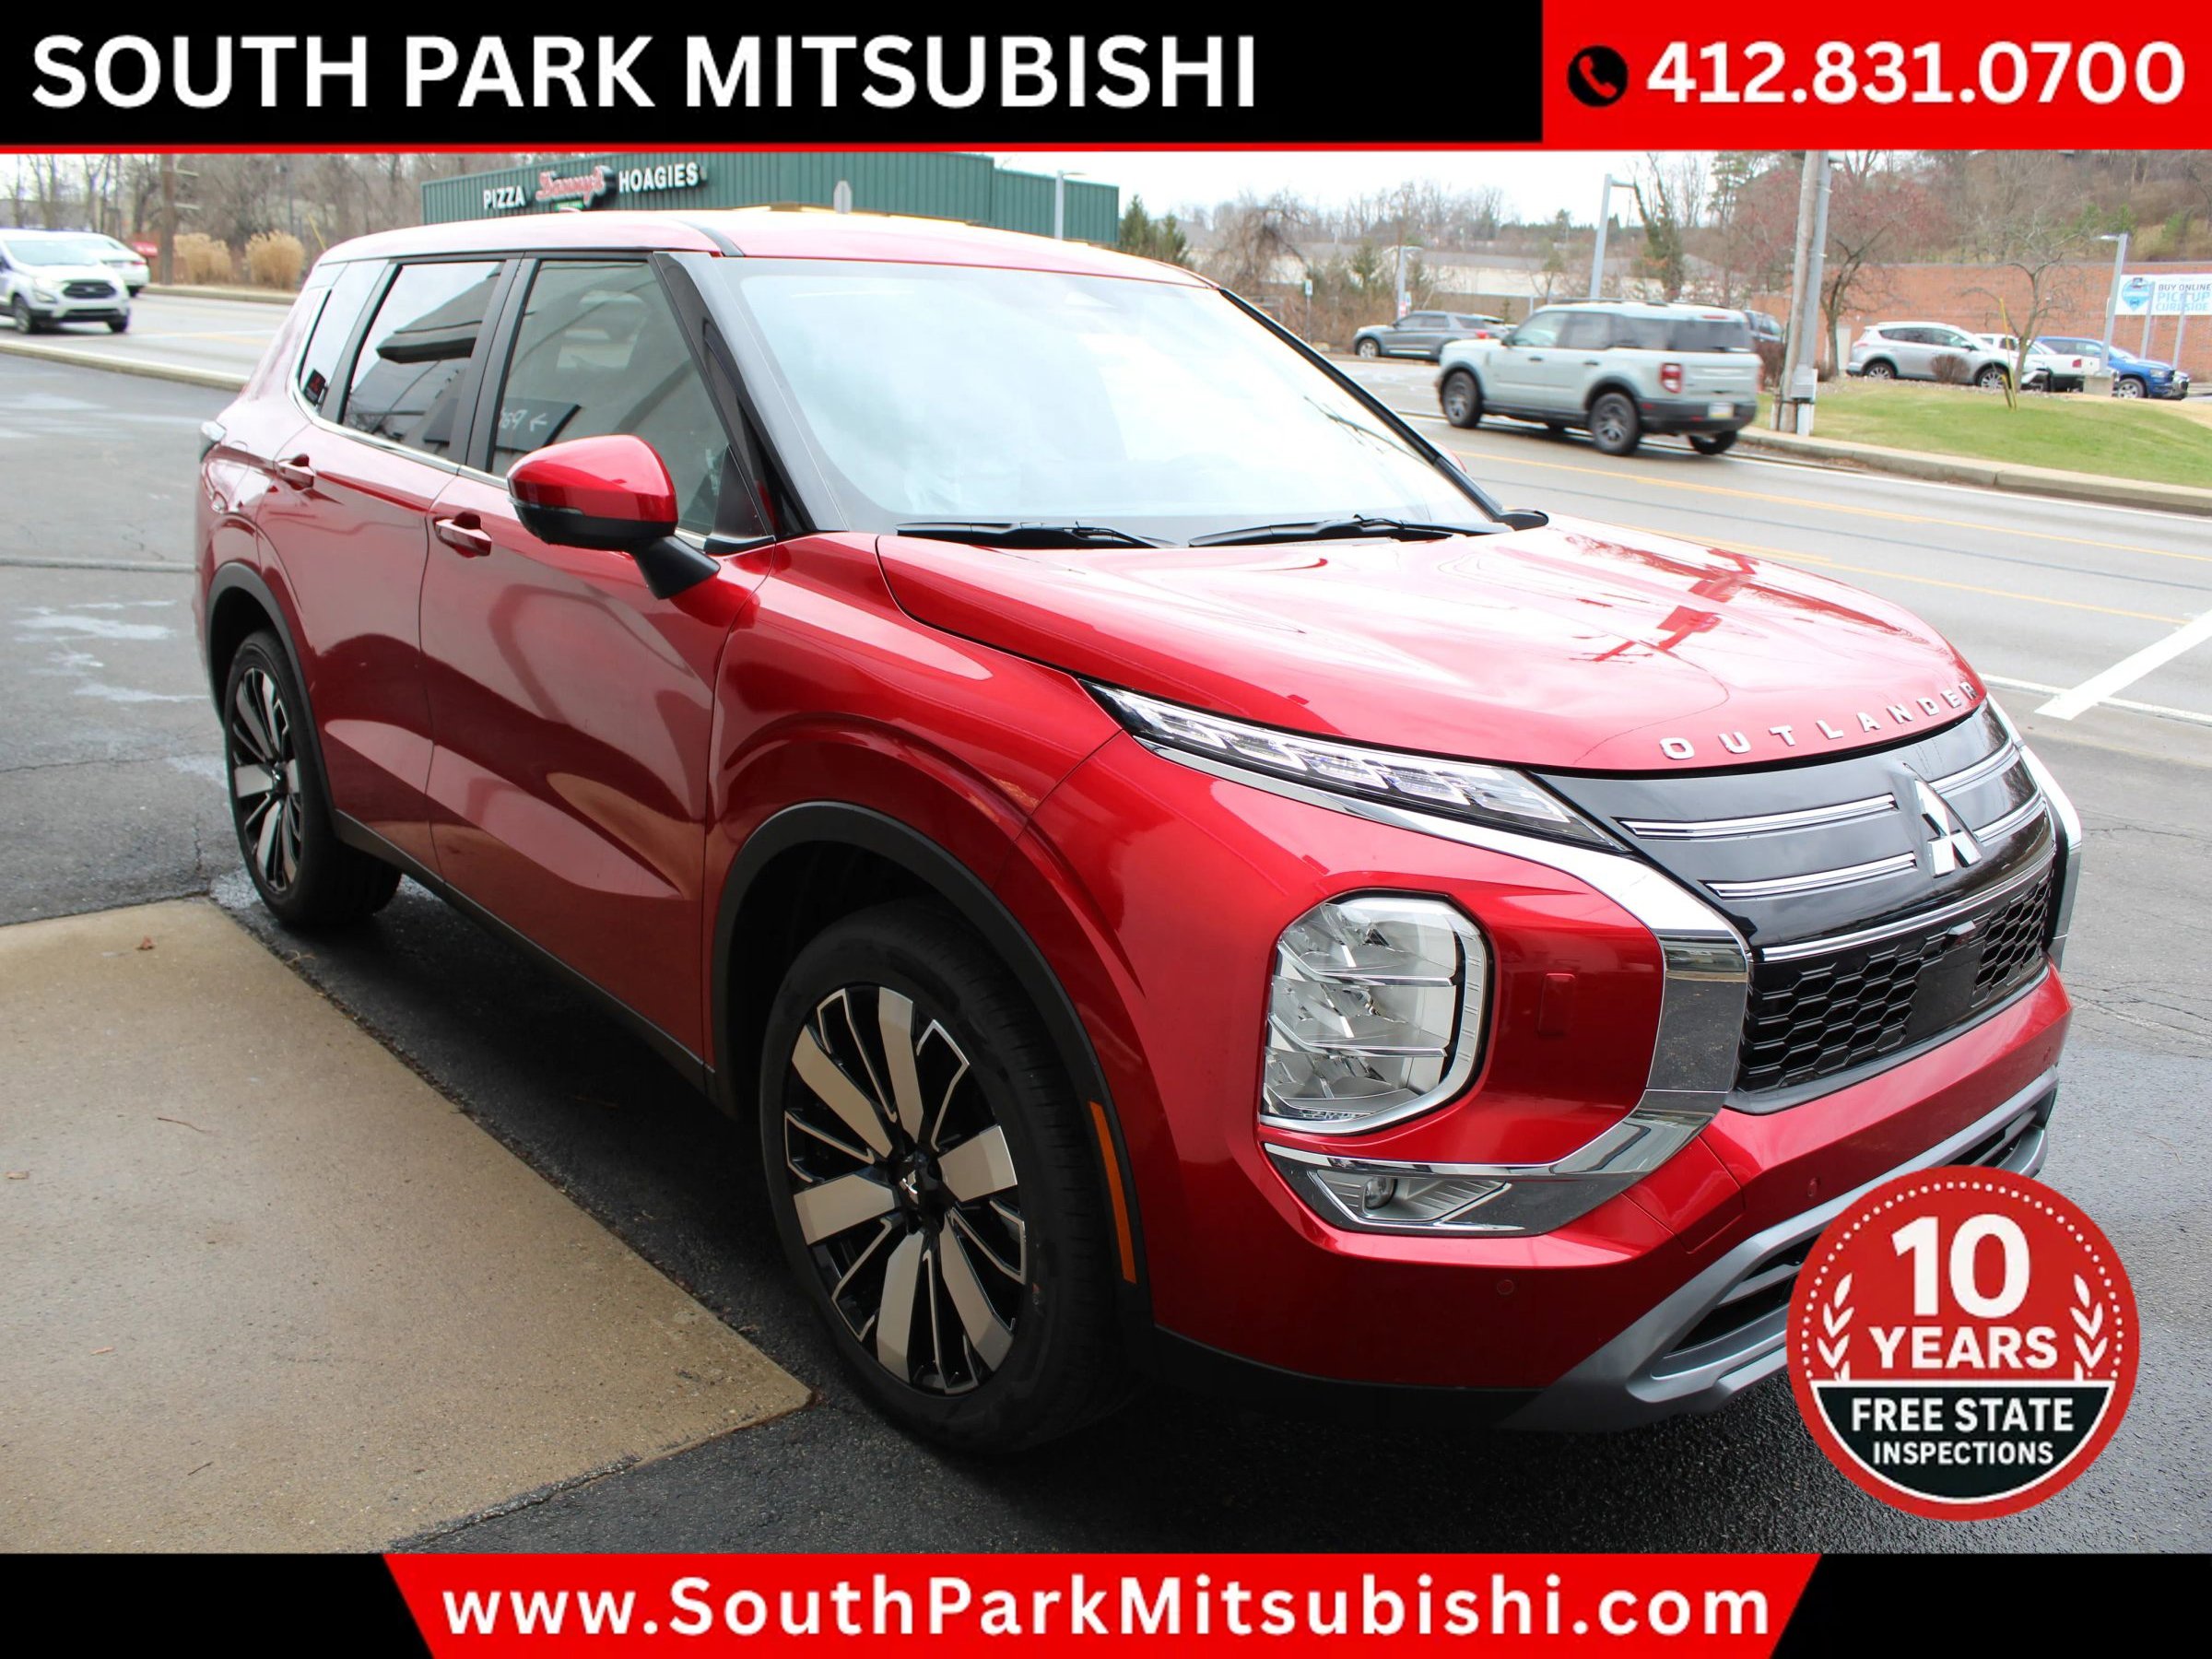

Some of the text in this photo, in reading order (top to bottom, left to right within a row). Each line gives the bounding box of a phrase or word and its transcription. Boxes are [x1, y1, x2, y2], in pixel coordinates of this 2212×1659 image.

[483, 185, 526, 209] PIZZA
[618, 162, 700, 193] HOAGIES
[1660, 681, 1979, 760] OUTLANDER
